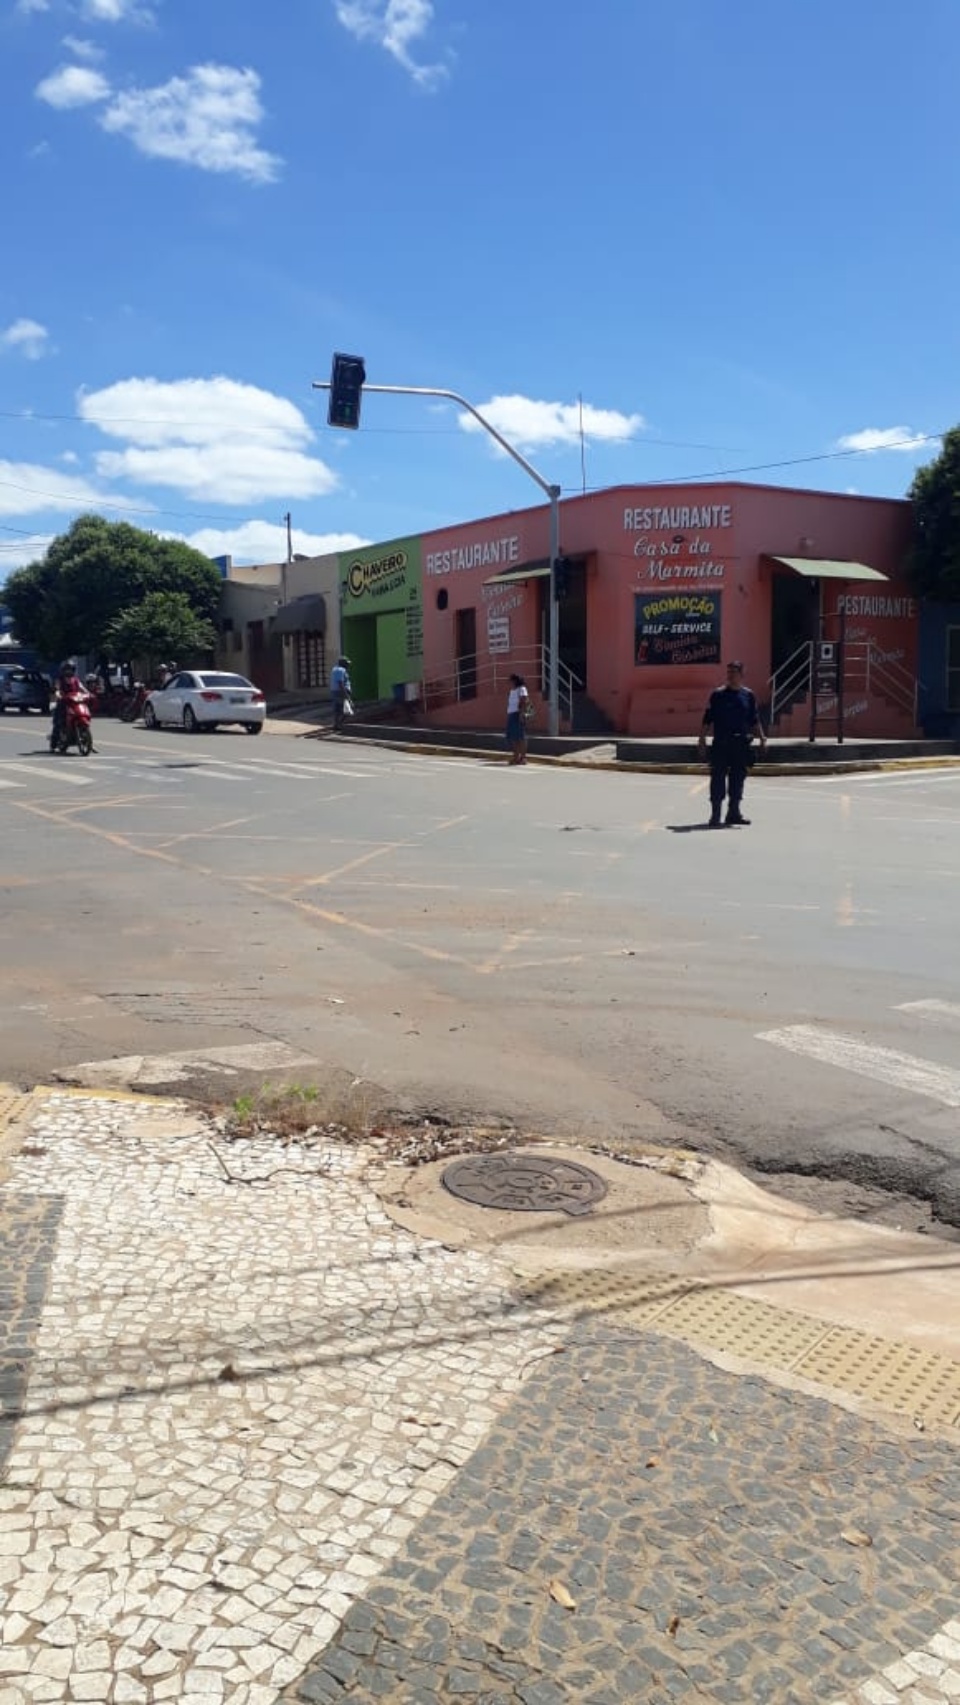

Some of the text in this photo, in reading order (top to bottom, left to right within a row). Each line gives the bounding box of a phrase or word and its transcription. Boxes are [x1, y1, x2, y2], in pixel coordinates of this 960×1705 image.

[624, 505, 732, 530] RESTAURANTE
[426, 536, 519, 576] RESTAURANTE
[634, 536, 711, 556] Casa da
[349, 552, 405, 592] CHAVERO
[637, 560, 725, 580] Marmita
[642, 596, 715, 620] PROMOÇÃO
[837, 595, 917, 618] RESTAURANTE
